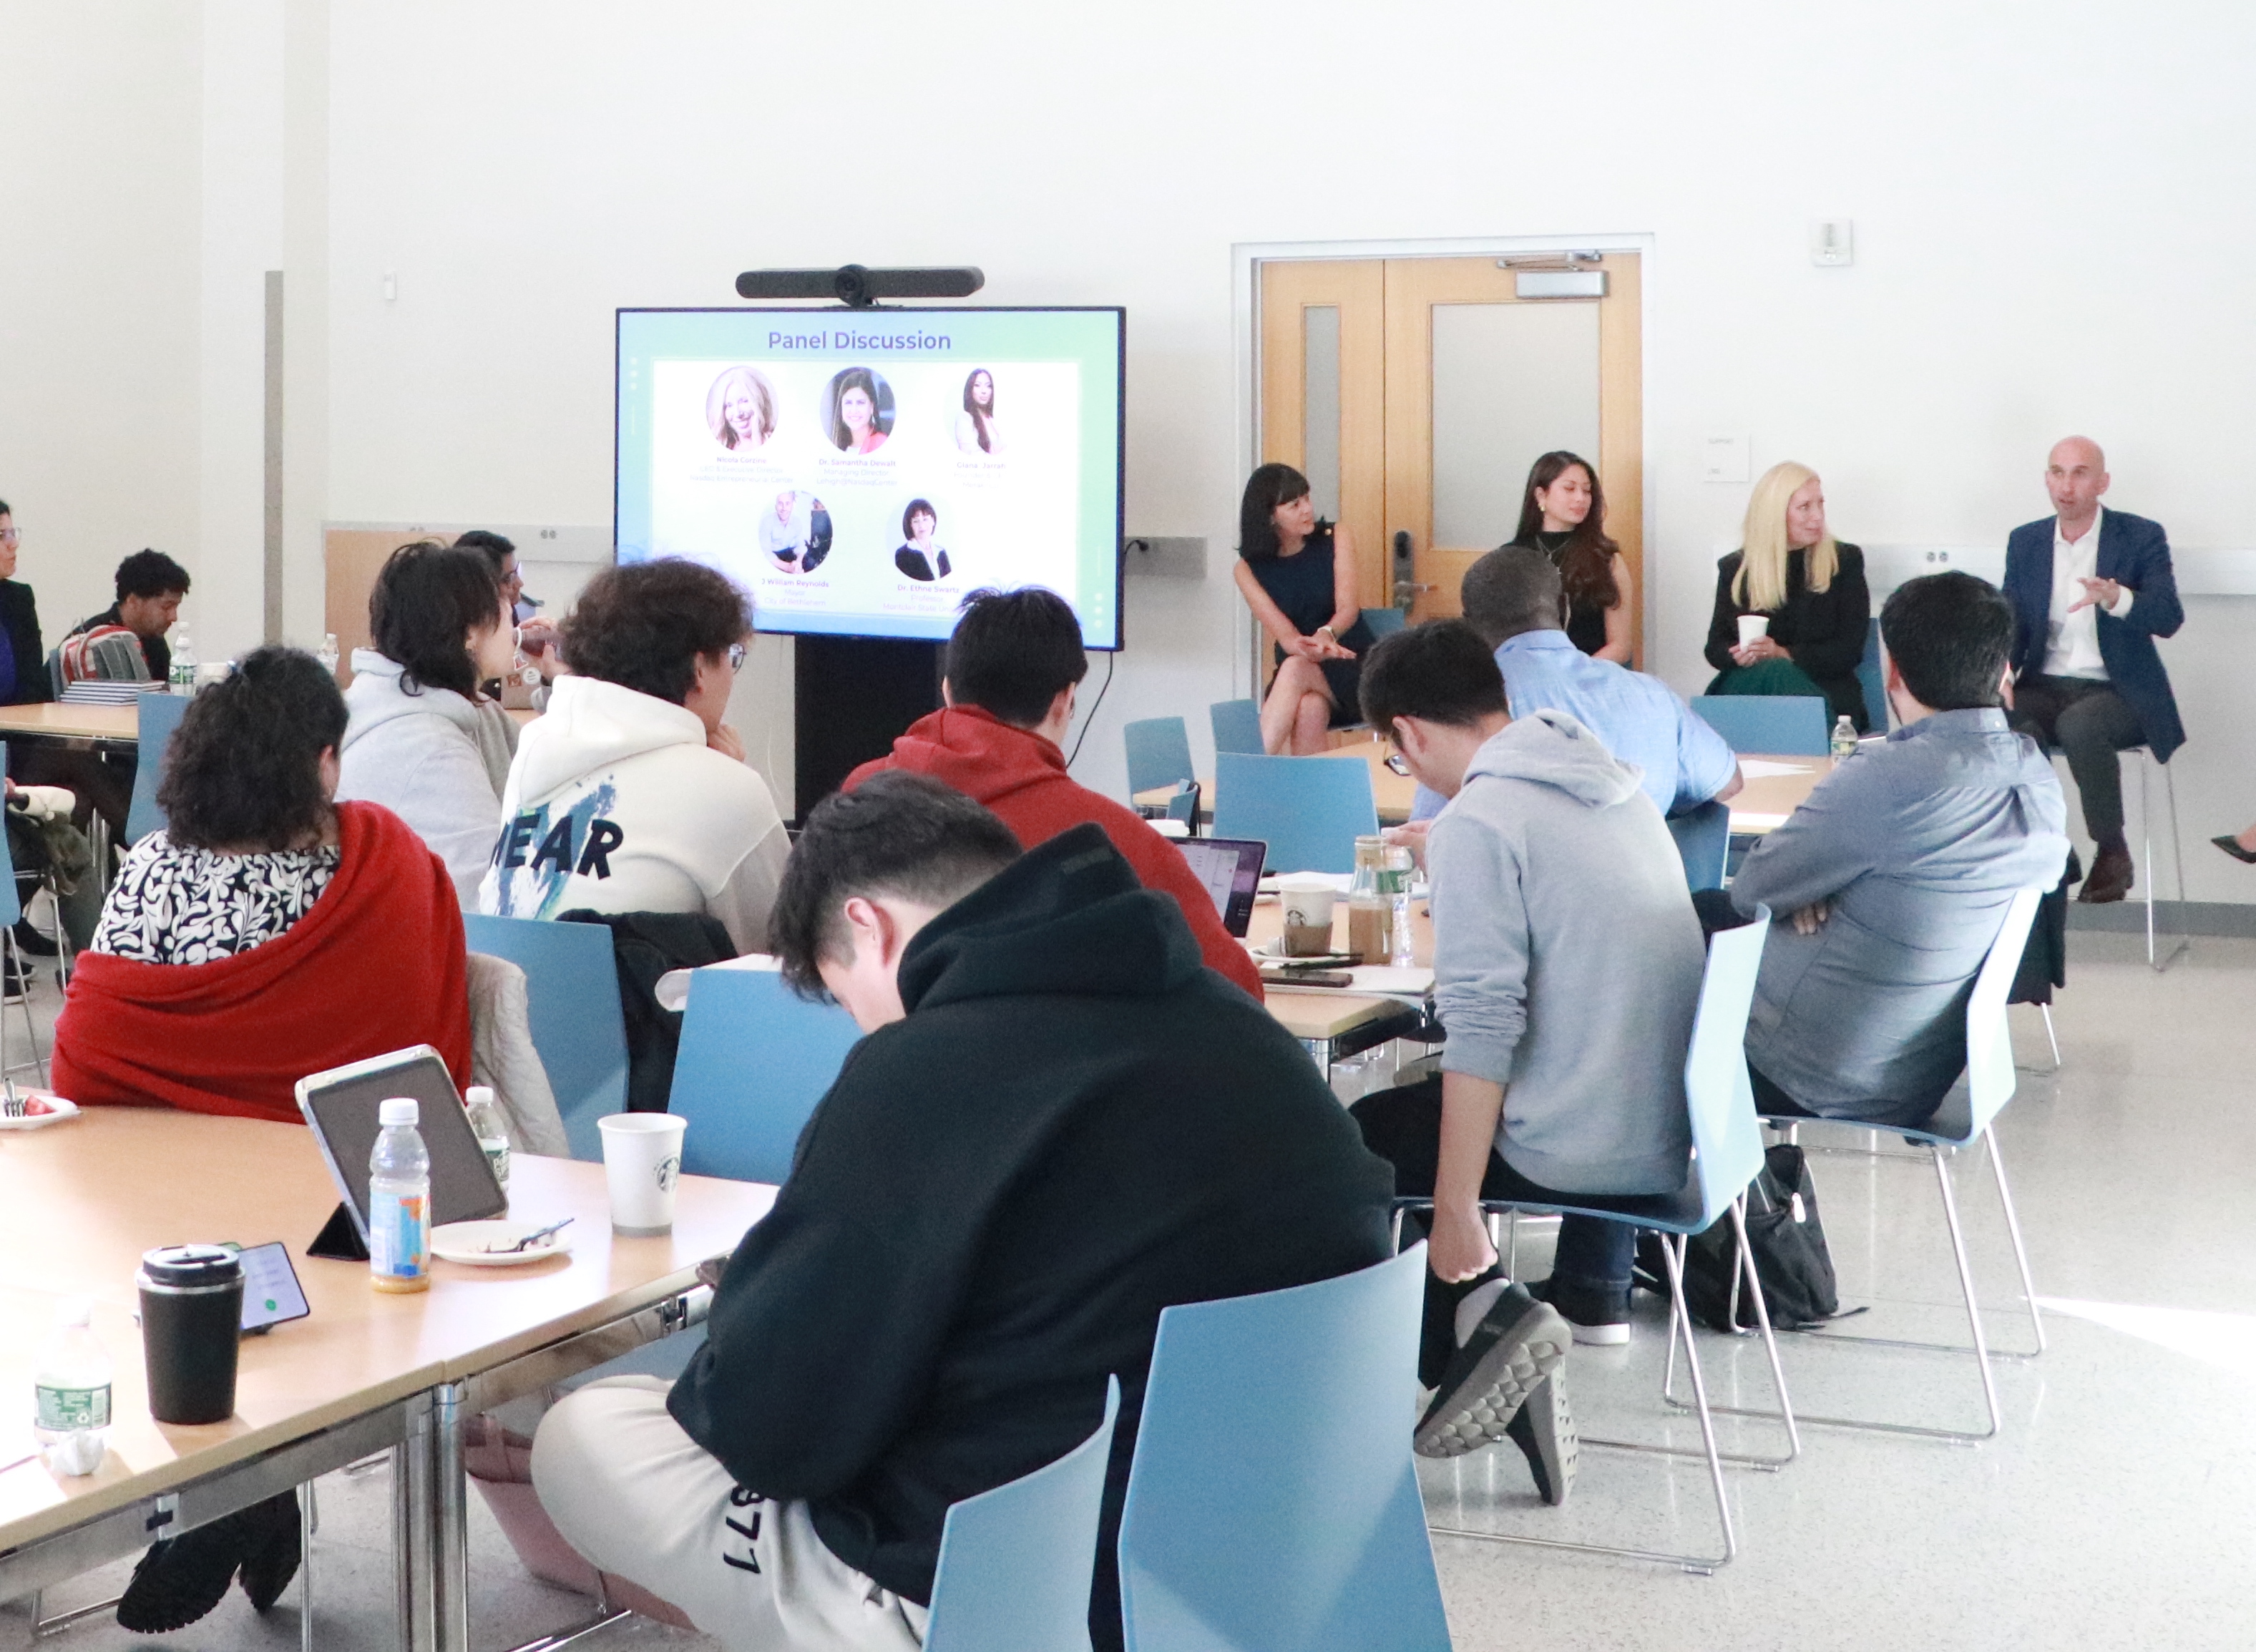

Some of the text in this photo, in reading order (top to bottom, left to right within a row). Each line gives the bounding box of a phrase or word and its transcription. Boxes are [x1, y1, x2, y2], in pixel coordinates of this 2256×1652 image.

[768, 330, 952, 349] Panel Discussion
[796, 580, 829, 588] Reynolds
